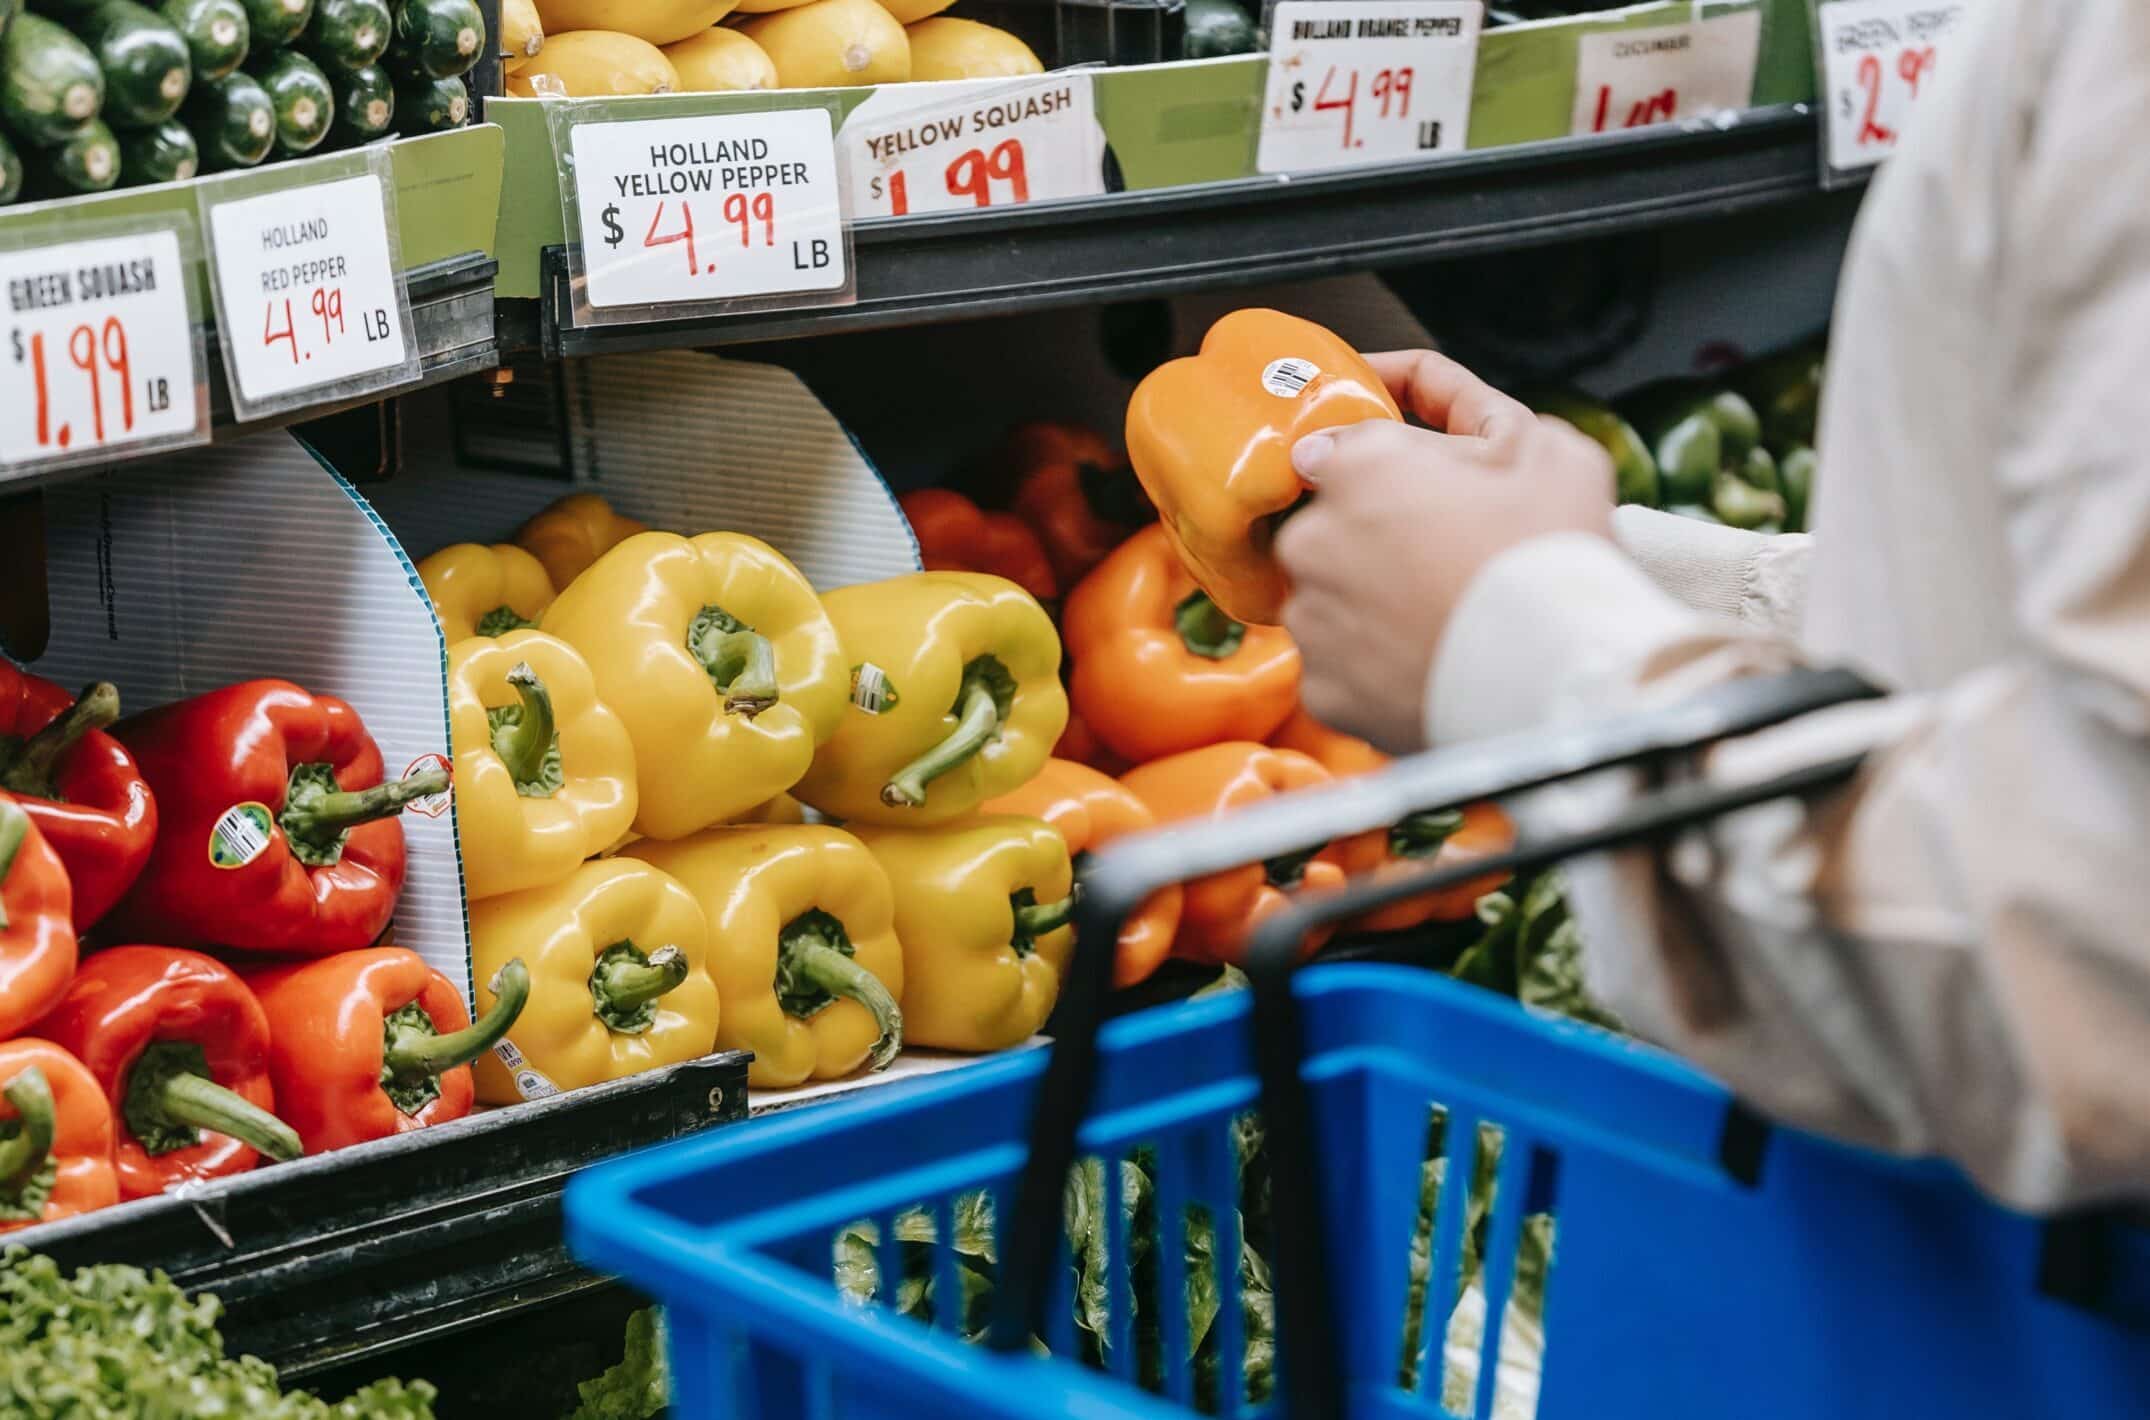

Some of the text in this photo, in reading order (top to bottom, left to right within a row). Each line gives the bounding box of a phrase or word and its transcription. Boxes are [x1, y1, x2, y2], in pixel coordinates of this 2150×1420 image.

[866, 87, 1072, 160] YELLOW SQUASH
[1417, 120, 1442, 150] LB
[650, 138, 768, 168] HOLLAND
[614, 162, 809, 198] YELLOW PEPPER
[262, 218, 328, 248] HOLLAND
[793, 239, 830, 270] LB
[9, 257, 157, 312] GREEN SQUASH
[261, 256, 347, 293] RED PEPPER
[263, 287, 390, 365] 4.99 LB
[147, 377, 169, 413] LB
